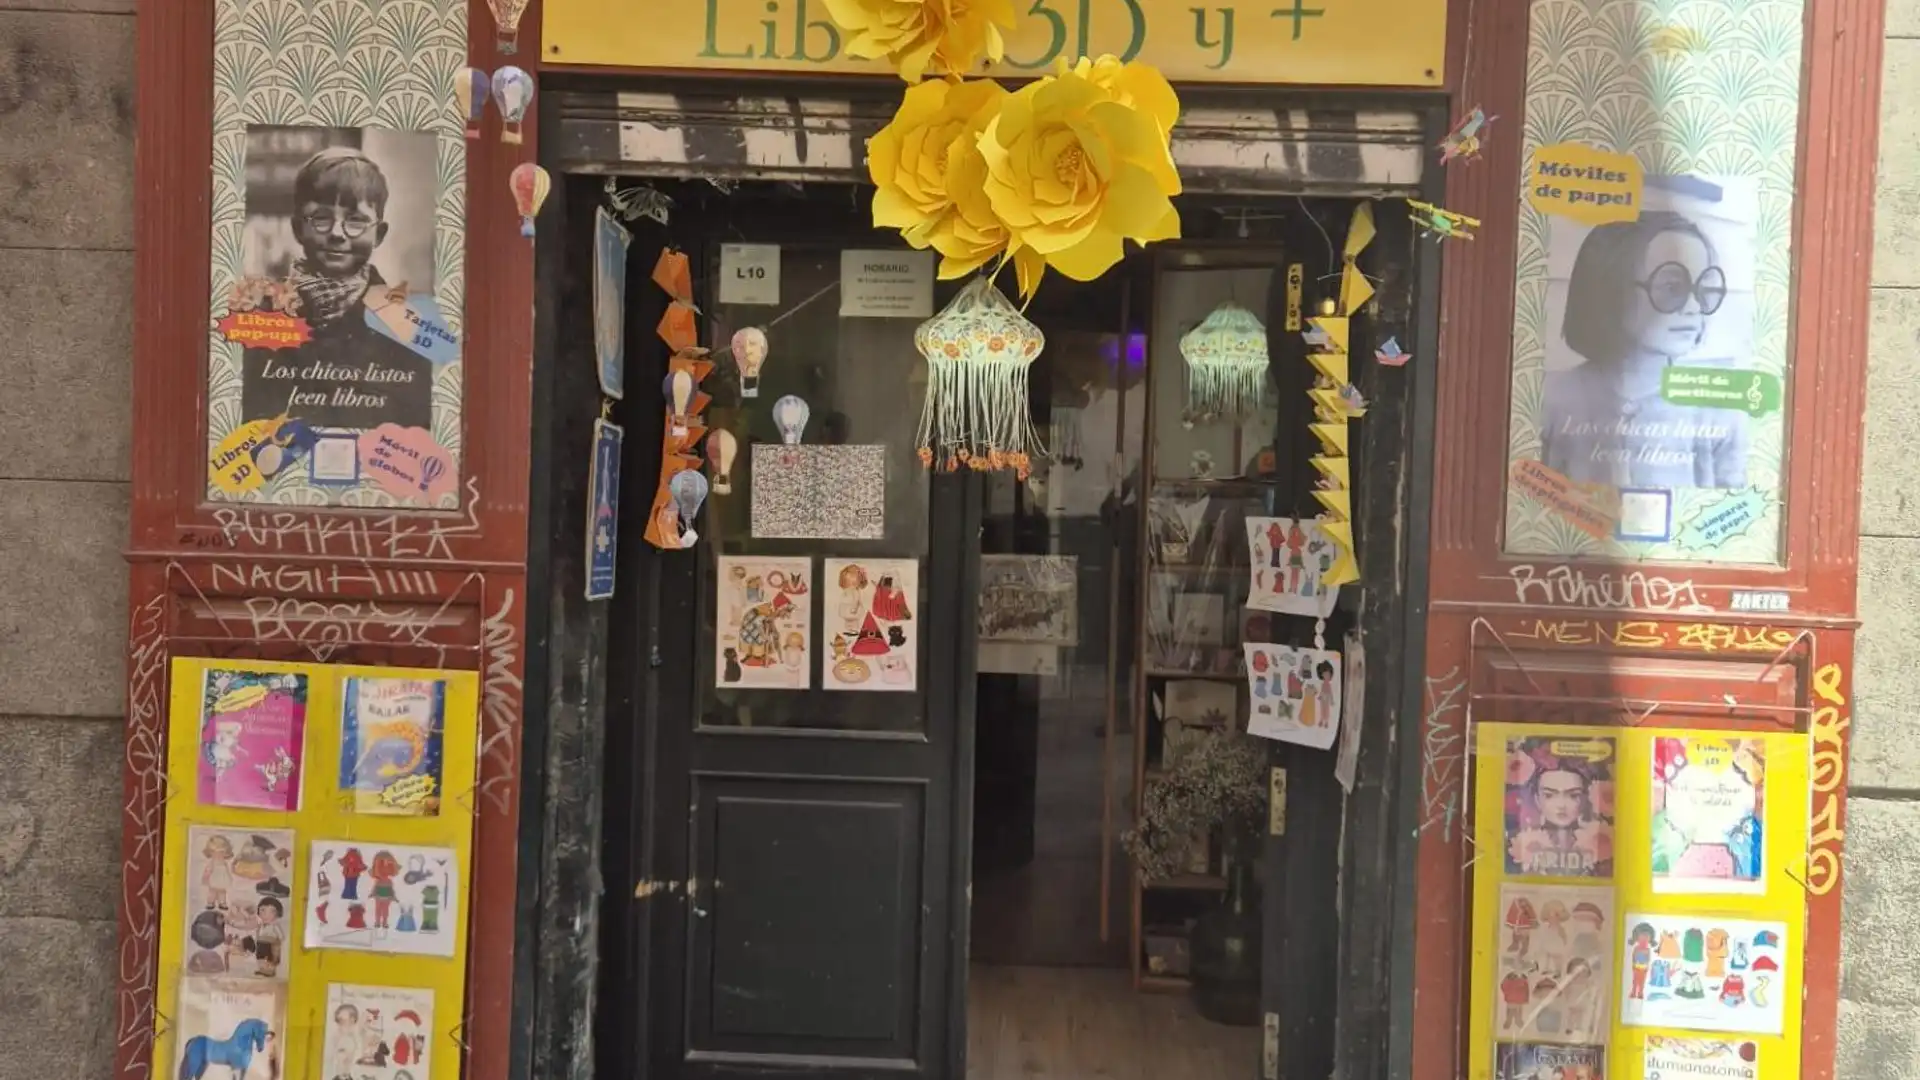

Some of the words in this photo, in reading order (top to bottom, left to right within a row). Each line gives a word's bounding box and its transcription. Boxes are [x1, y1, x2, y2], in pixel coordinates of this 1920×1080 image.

[1189, 7, 1235, 70] y
[1538, 161, 1628, 183] Móviles
[1536, 184, 1562, 199] de
[1568, 189, 1633, 206] papel
[737, 267, 765, 279] L10
[864, 264, 909, 273] HORARIO
[237, 313, 296, 328] Libros
[404, 308, 457, 345] Tarjetas
[411, 334, 433, 350] 3D
[261, 359, 296, 379] Los
[301, 361, 359, 382] chicos
[364, 362, 416, 383] listos
[287, 386, 333, 407] leen
[330, 387, 388, 408] libros
[211, 434, 257, 472] Libros
[1637, 442, 1698, 466] libros
[230, 465, 252, 486] 3D
